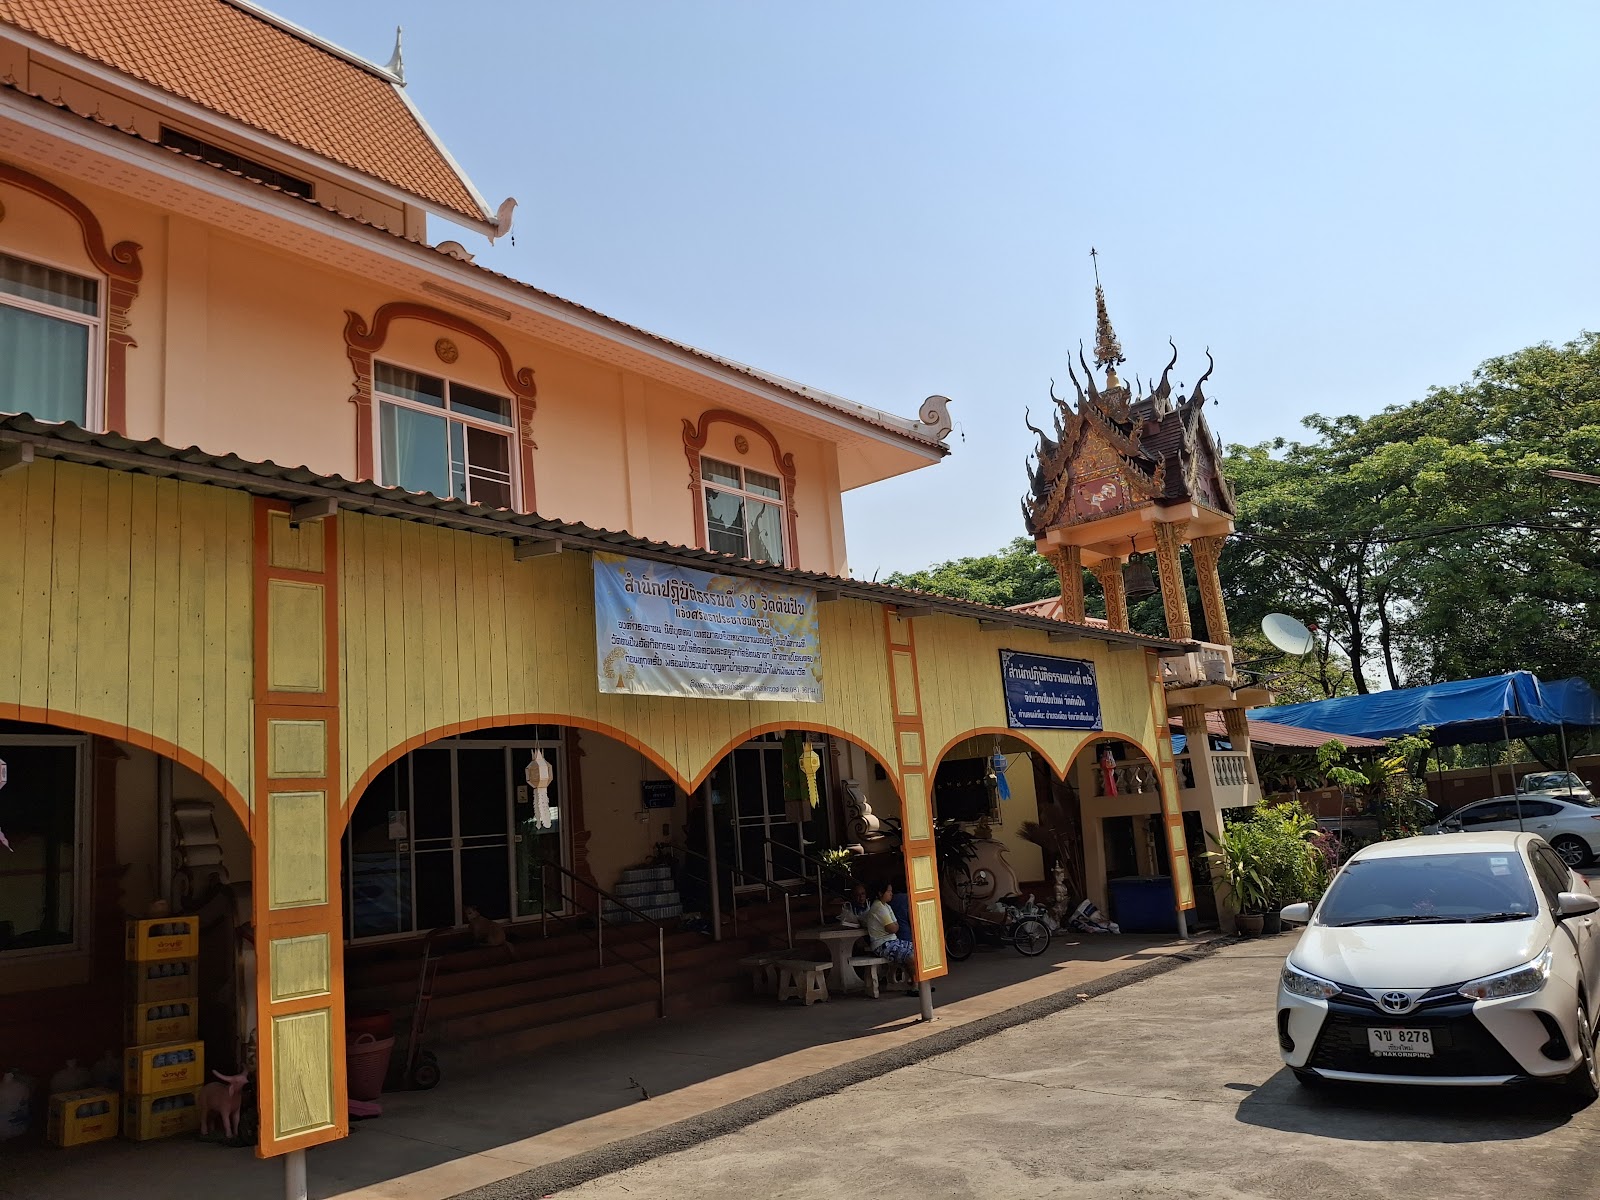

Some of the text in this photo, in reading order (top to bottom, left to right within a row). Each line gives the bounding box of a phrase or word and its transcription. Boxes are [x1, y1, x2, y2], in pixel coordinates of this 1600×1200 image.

[624, 571, 805, 615] สำนักปฏิบัติธรรมที่ 36 วัดต้นปิน
[1398, 1030, 1429, 1043] 8278
